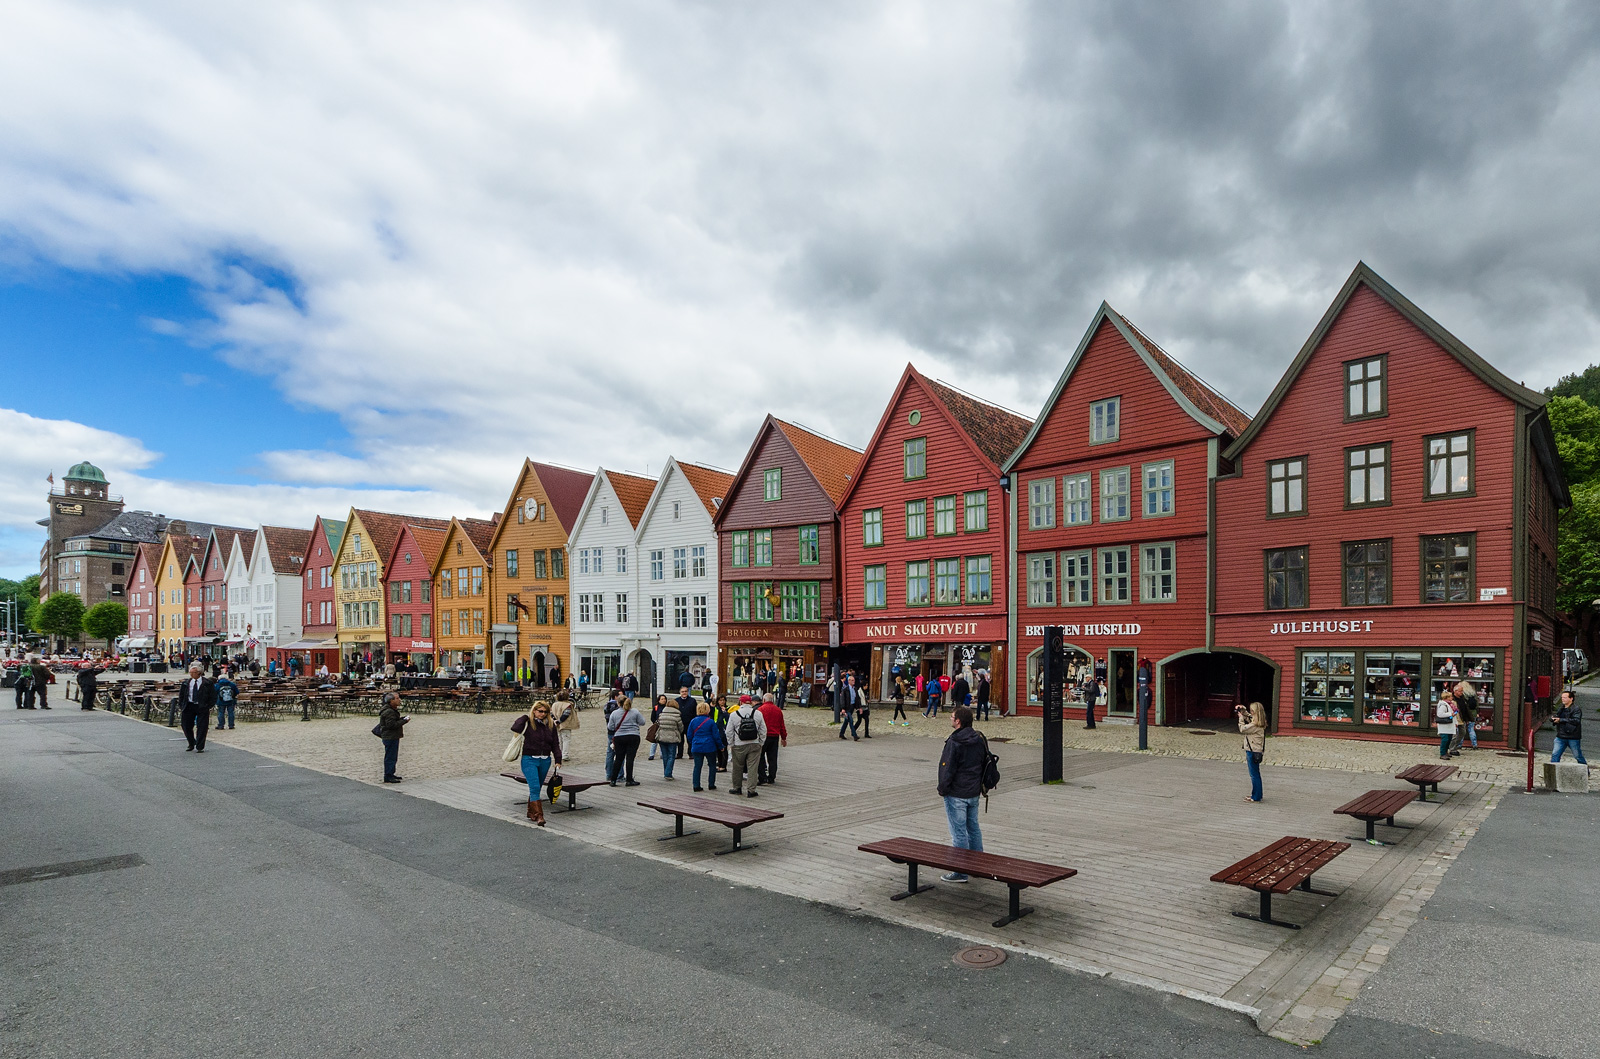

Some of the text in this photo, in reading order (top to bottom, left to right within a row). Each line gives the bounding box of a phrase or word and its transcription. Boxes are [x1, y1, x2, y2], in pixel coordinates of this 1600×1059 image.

[866, 622, 978, 637] KNUT SKURTVEIT
[1025, 623, 1141, 636] BRYEN HUSFLID
[1270, 620, 1374, 634] JULEHUSET
[727, 629, 823, 639] BRYGGEN HANDEL
